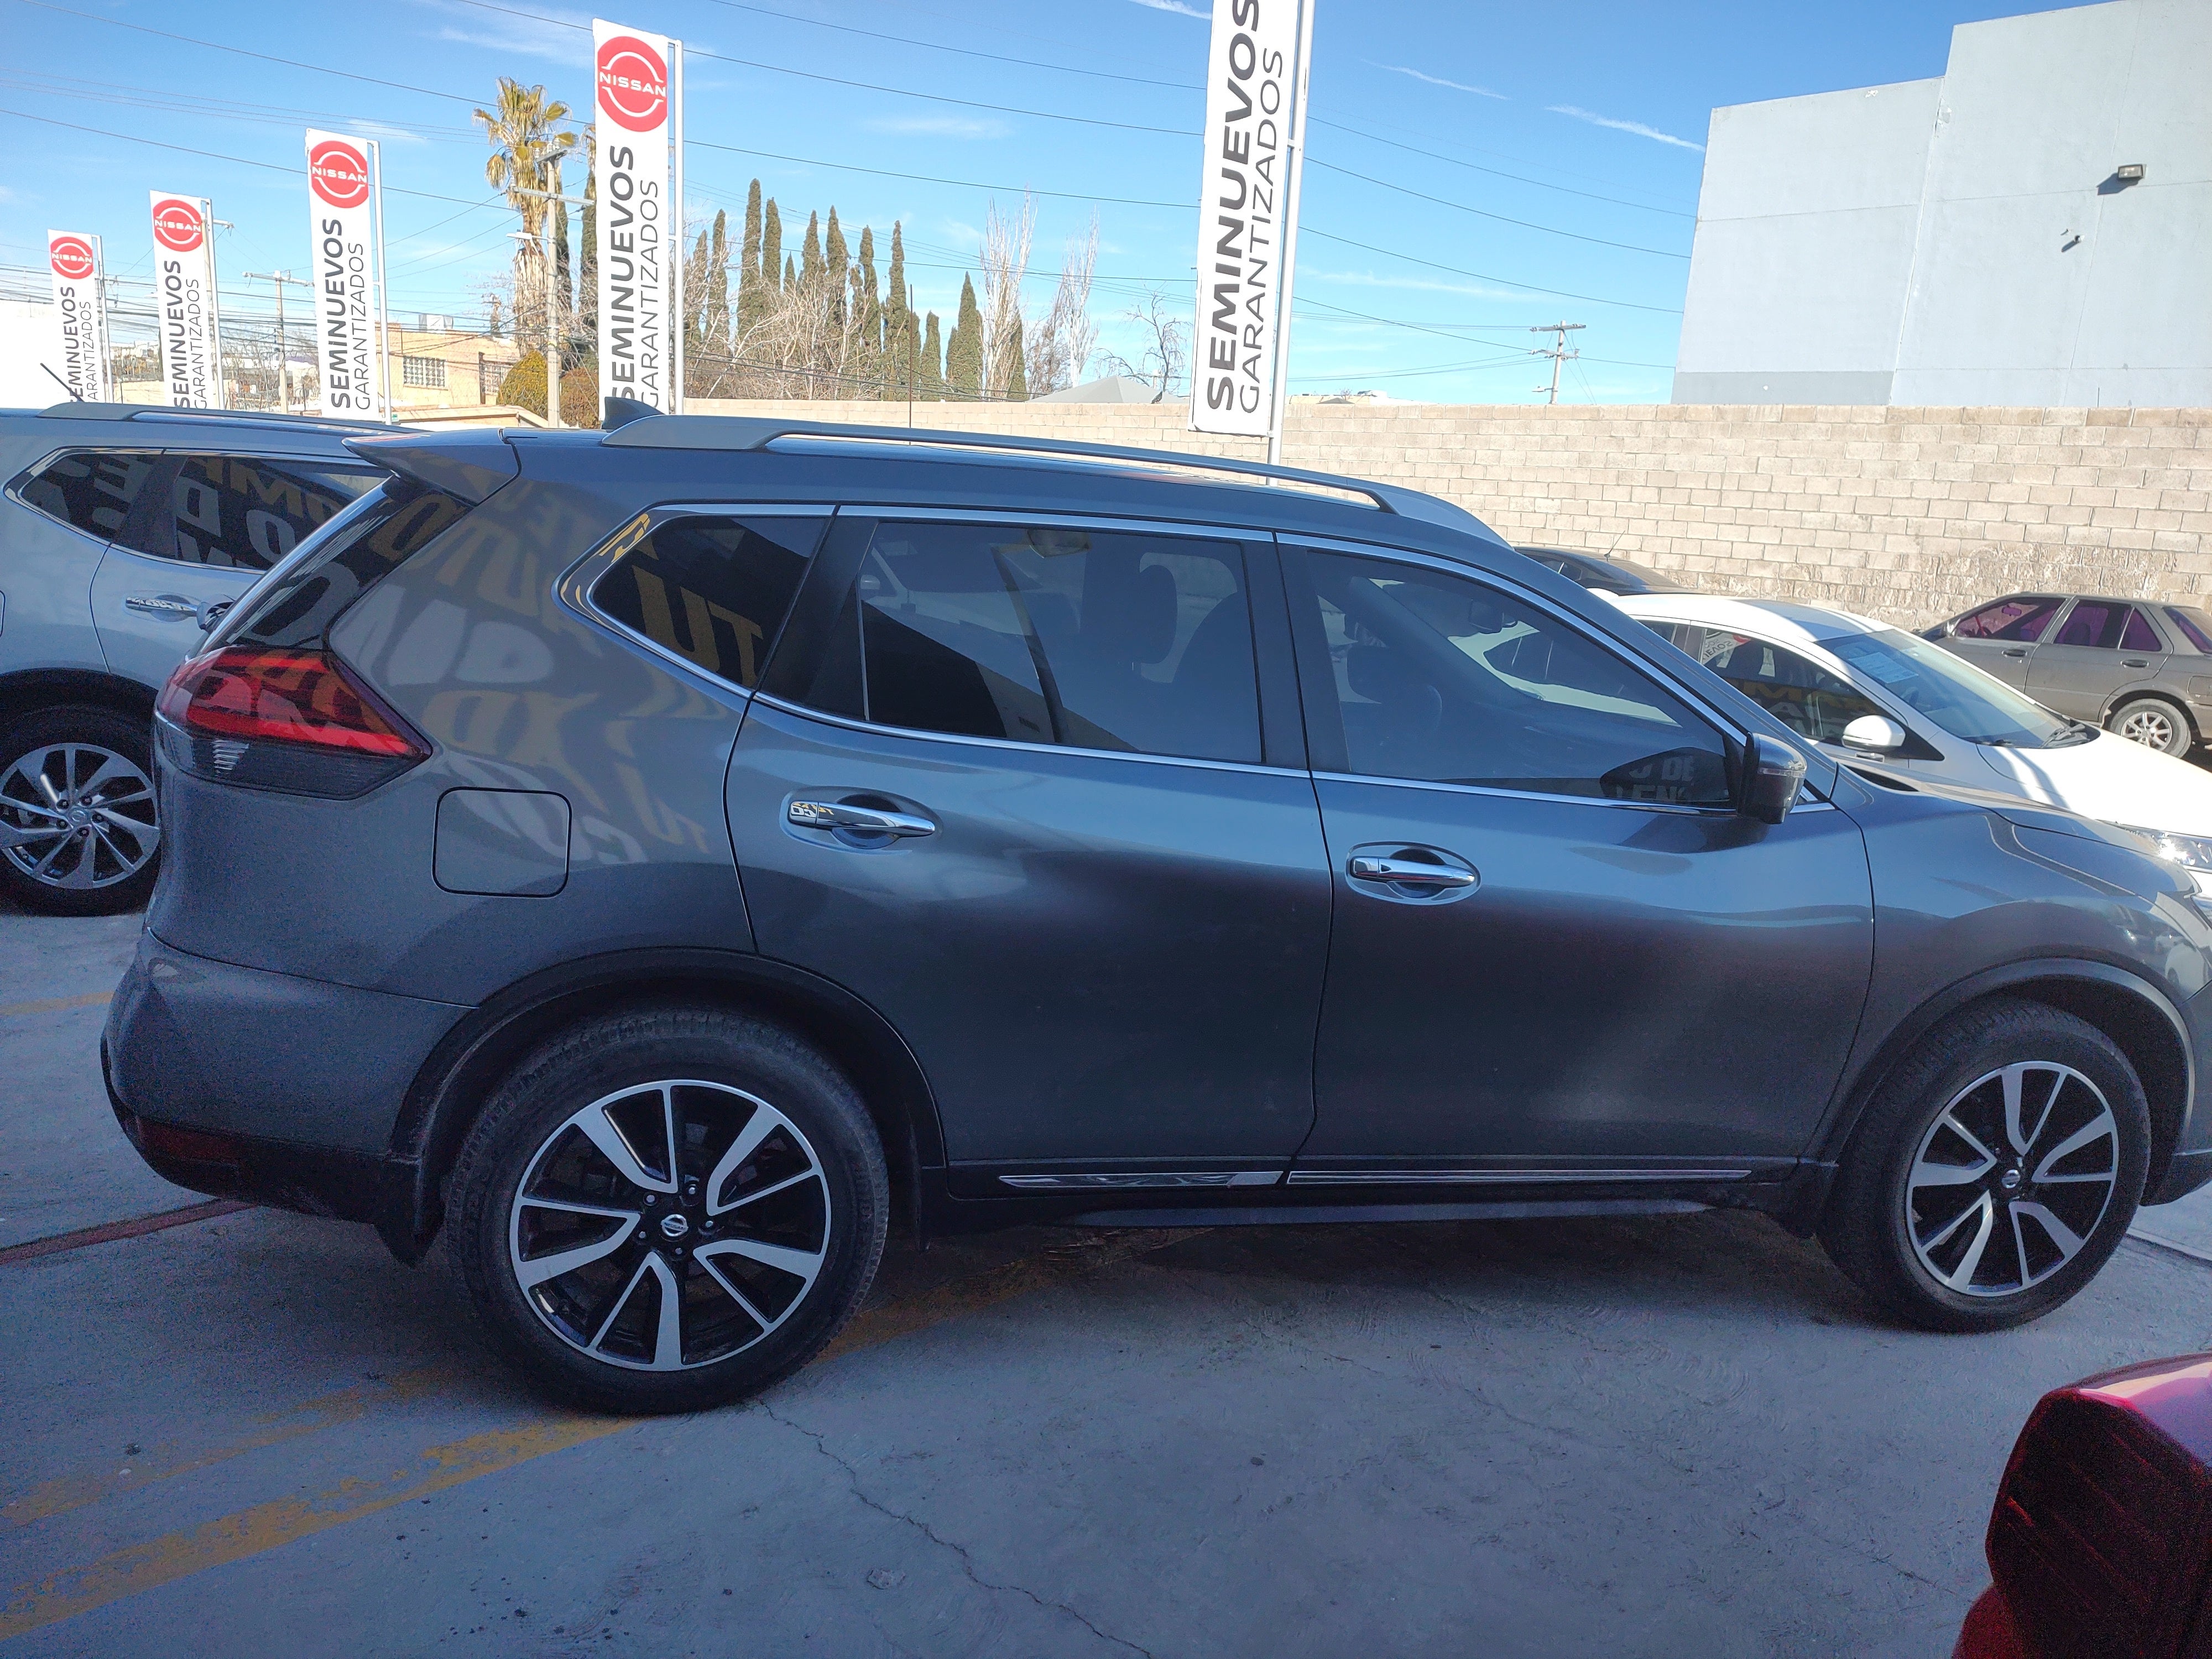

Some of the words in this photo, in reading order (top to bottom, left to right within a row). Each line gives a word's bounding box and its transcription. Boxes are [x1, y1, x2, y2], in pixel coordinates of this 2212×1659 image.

[599, 71, 666, 97] NISSAN
[154, 219, 201, 233] NISSAN
[311, 166, 367, 184] NISSAN
[51, 253, 93, 264] NISSAN
[1240, 48, 1282, 413] GARANTIZADOS
[60, 286, 84, 402] EMINUEVOS
[80, 301, 98, 400] ARANTIZADOS
[164, 260, 190, 408] SEMINUEVOS
[322, 219, 351, 408] SEMINUEVOS
[348, 243, 371, 410] GARANTIZADOS
